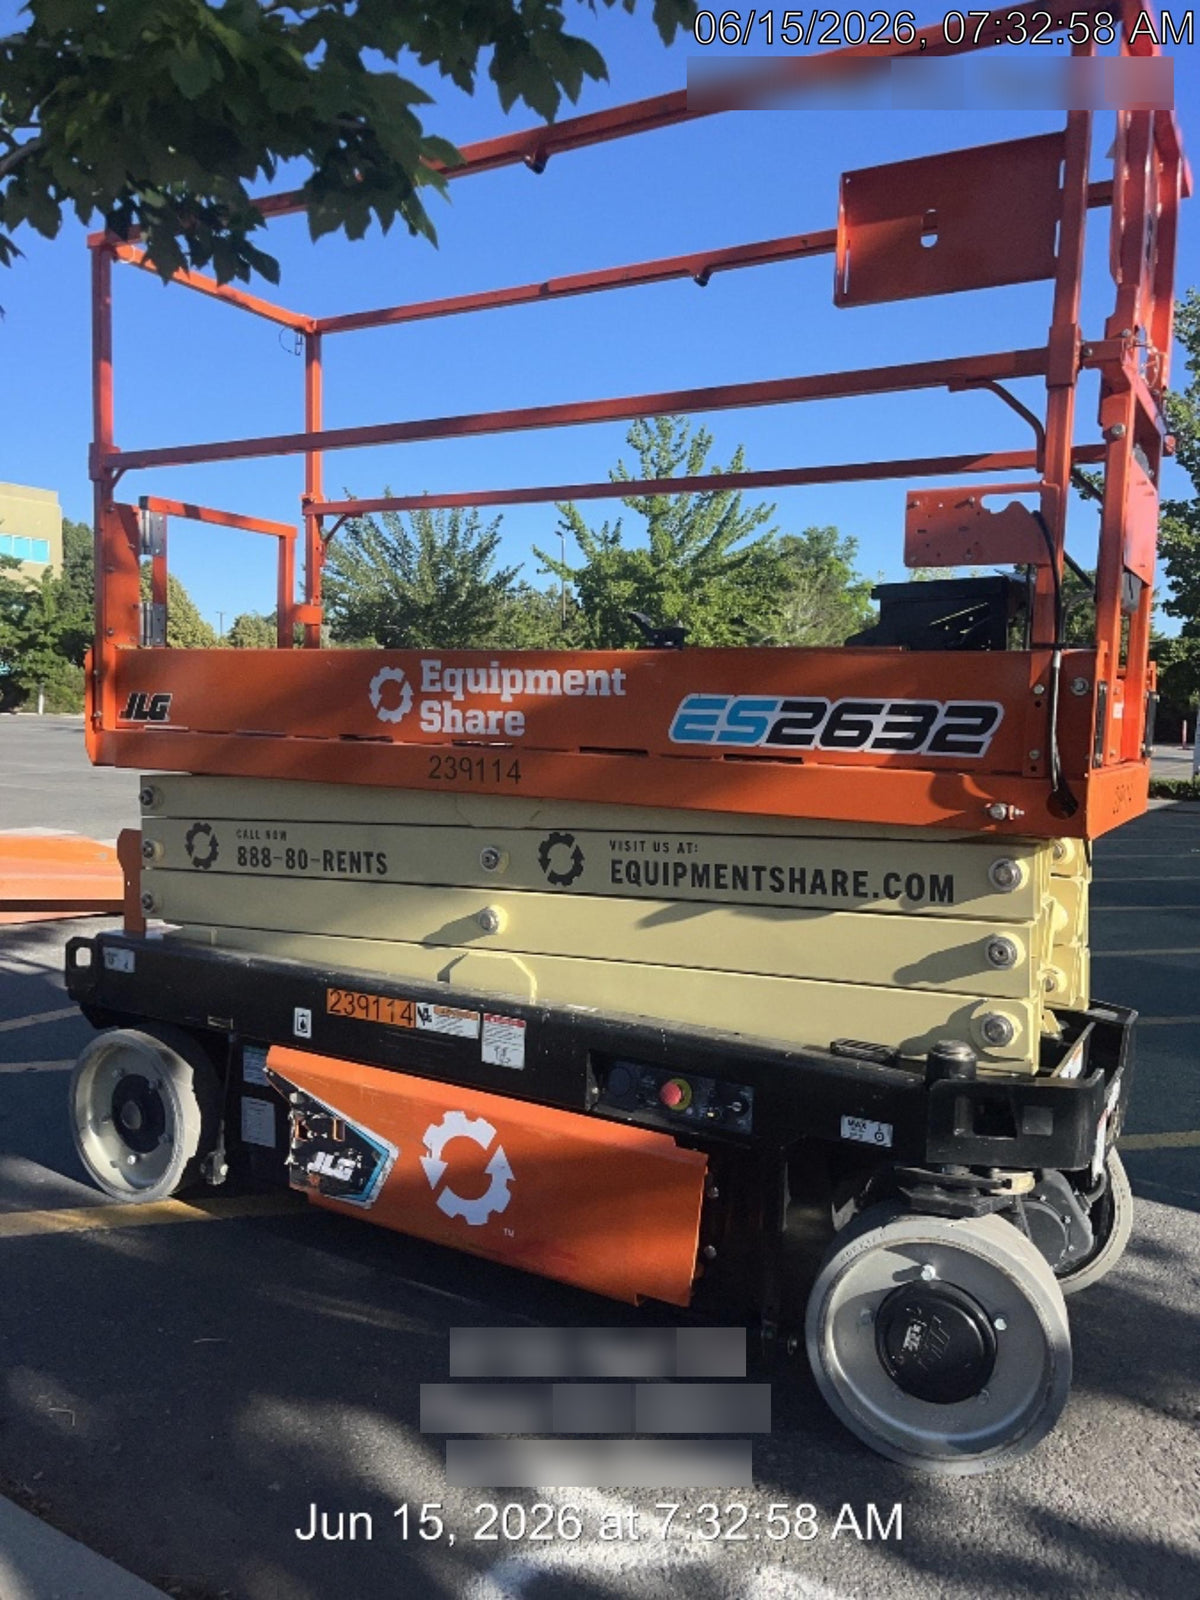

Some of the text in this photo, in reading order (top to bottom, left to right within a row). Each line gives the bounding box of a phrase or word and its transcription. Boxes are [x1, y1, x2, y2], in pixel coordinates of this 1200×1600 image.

[420, 659, 627, 702] Equipment
[119, 692, 173, 723] JLG
[420, 701, 526, 737] Share
[669, 693, 1005, 758] ES2632
[428, 755, 522, 784] 239114
[236, 828, 287, 841] CALL NOW
[609, 839, 698, 854] VISIT US AT:
[237, 845, 388, 875] 888-80-RENTS
[610, 858, 955, 904] EQUIPMENTSHARE.COM
[328, 988, 414, 1027] 239114
[307, 1151, 357, 1182] JLG
